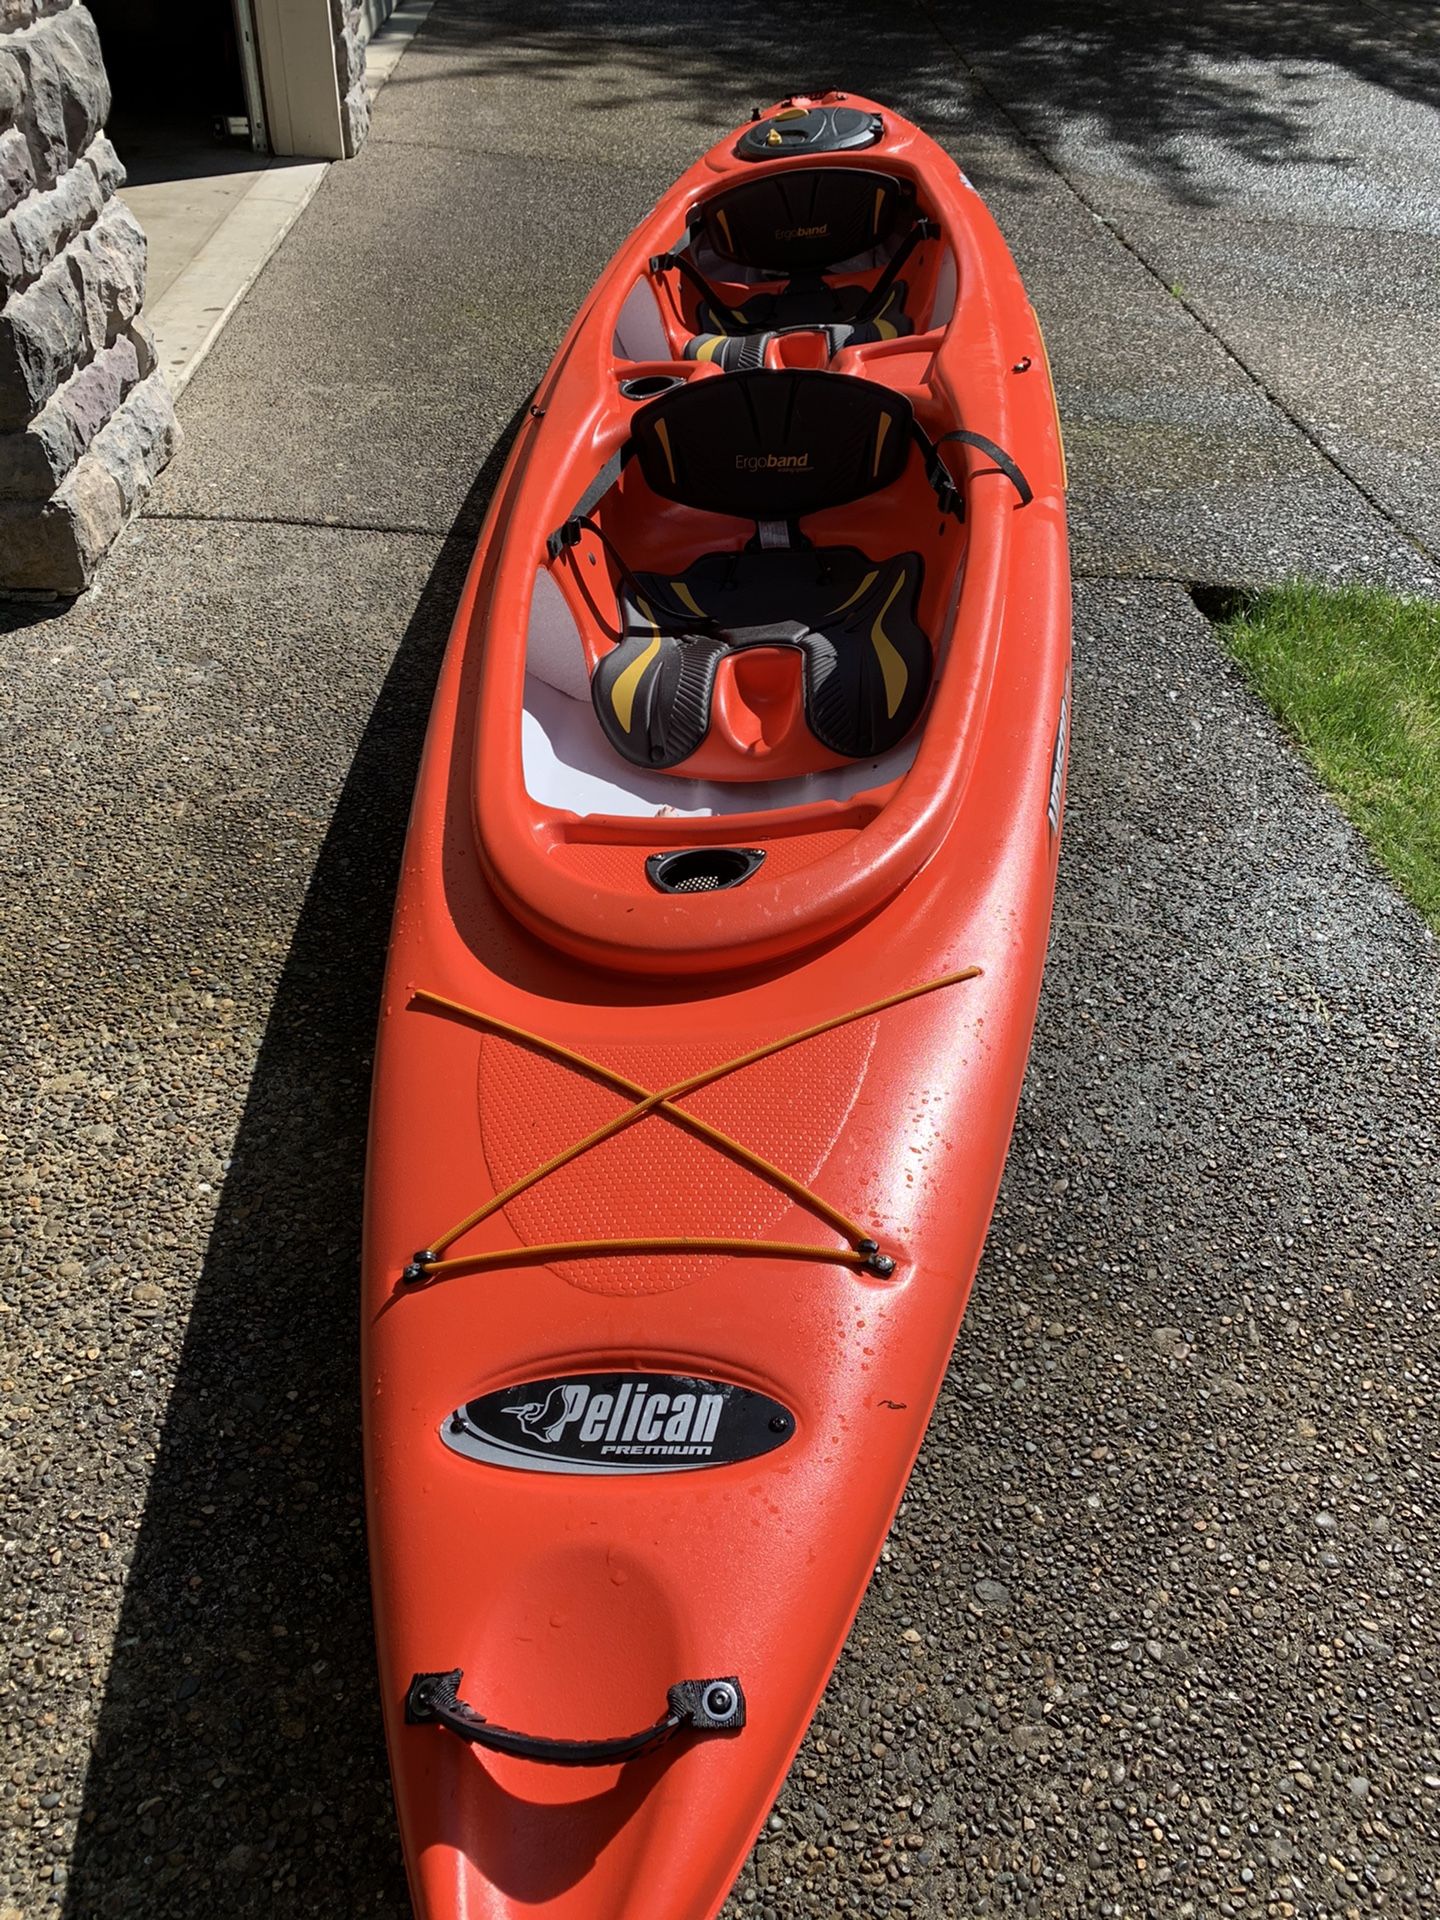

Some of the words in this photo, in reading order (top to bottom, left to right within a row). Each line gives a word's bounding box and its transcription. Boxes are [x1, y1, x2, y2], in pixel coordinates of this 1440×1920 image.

[735, 453, 808, 472] Ergoband
[551, 1383, 724, 1443] Pelican
[600, 1445, 712, 1456] PREMIUM
